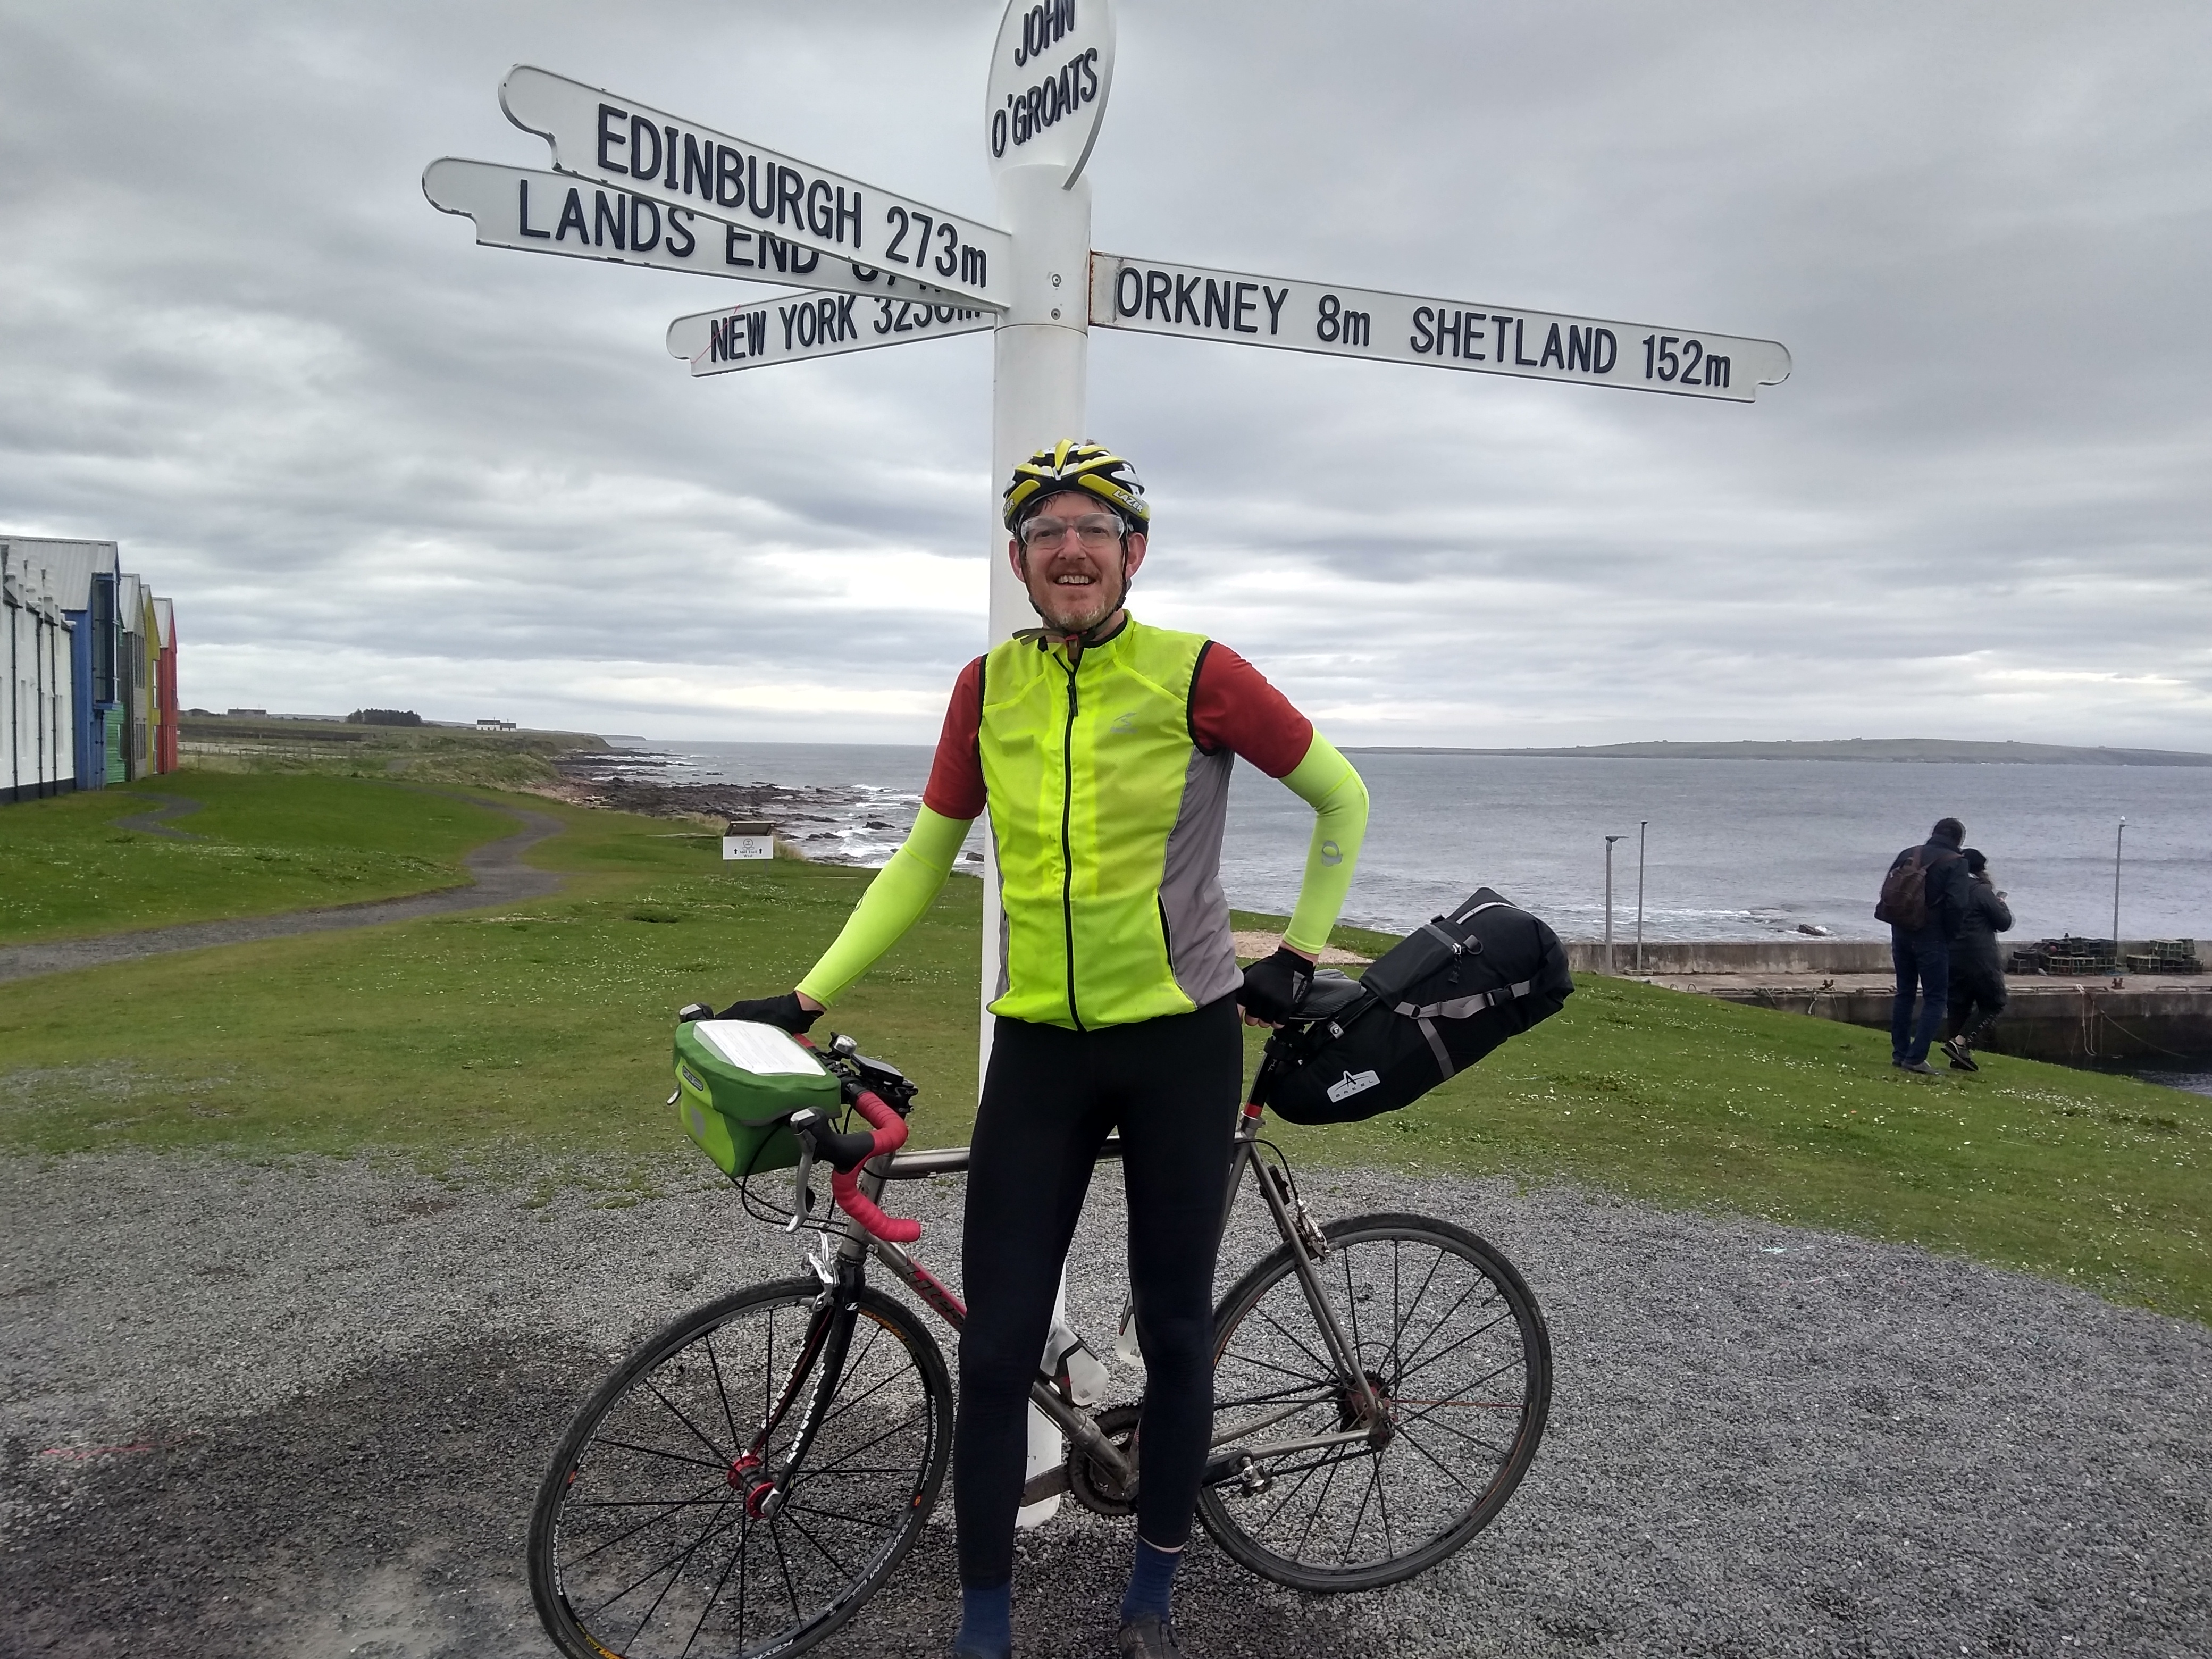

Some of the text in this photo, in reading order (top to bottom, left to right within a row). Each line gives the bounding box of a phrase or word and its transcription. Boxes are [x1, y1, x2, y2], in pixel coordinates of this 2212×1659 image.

[1015, 0, 1076, 67] JOHN
[992, 47, 1097, 158] O'GROATS
[519, 180, 696, 257] LANDS
[598, 103, 987, 288] EDINBURGH 273m
[711, 310, 766, 363] NEW
[778, 295, 858, 349] YORK
[1117, 267, 1730, 388] ORKNEY 8m SHETLAND 152m
[1113, 490, 1143, 513] LAZER
[553, 1524, 563, 1595] KSYRIUM
